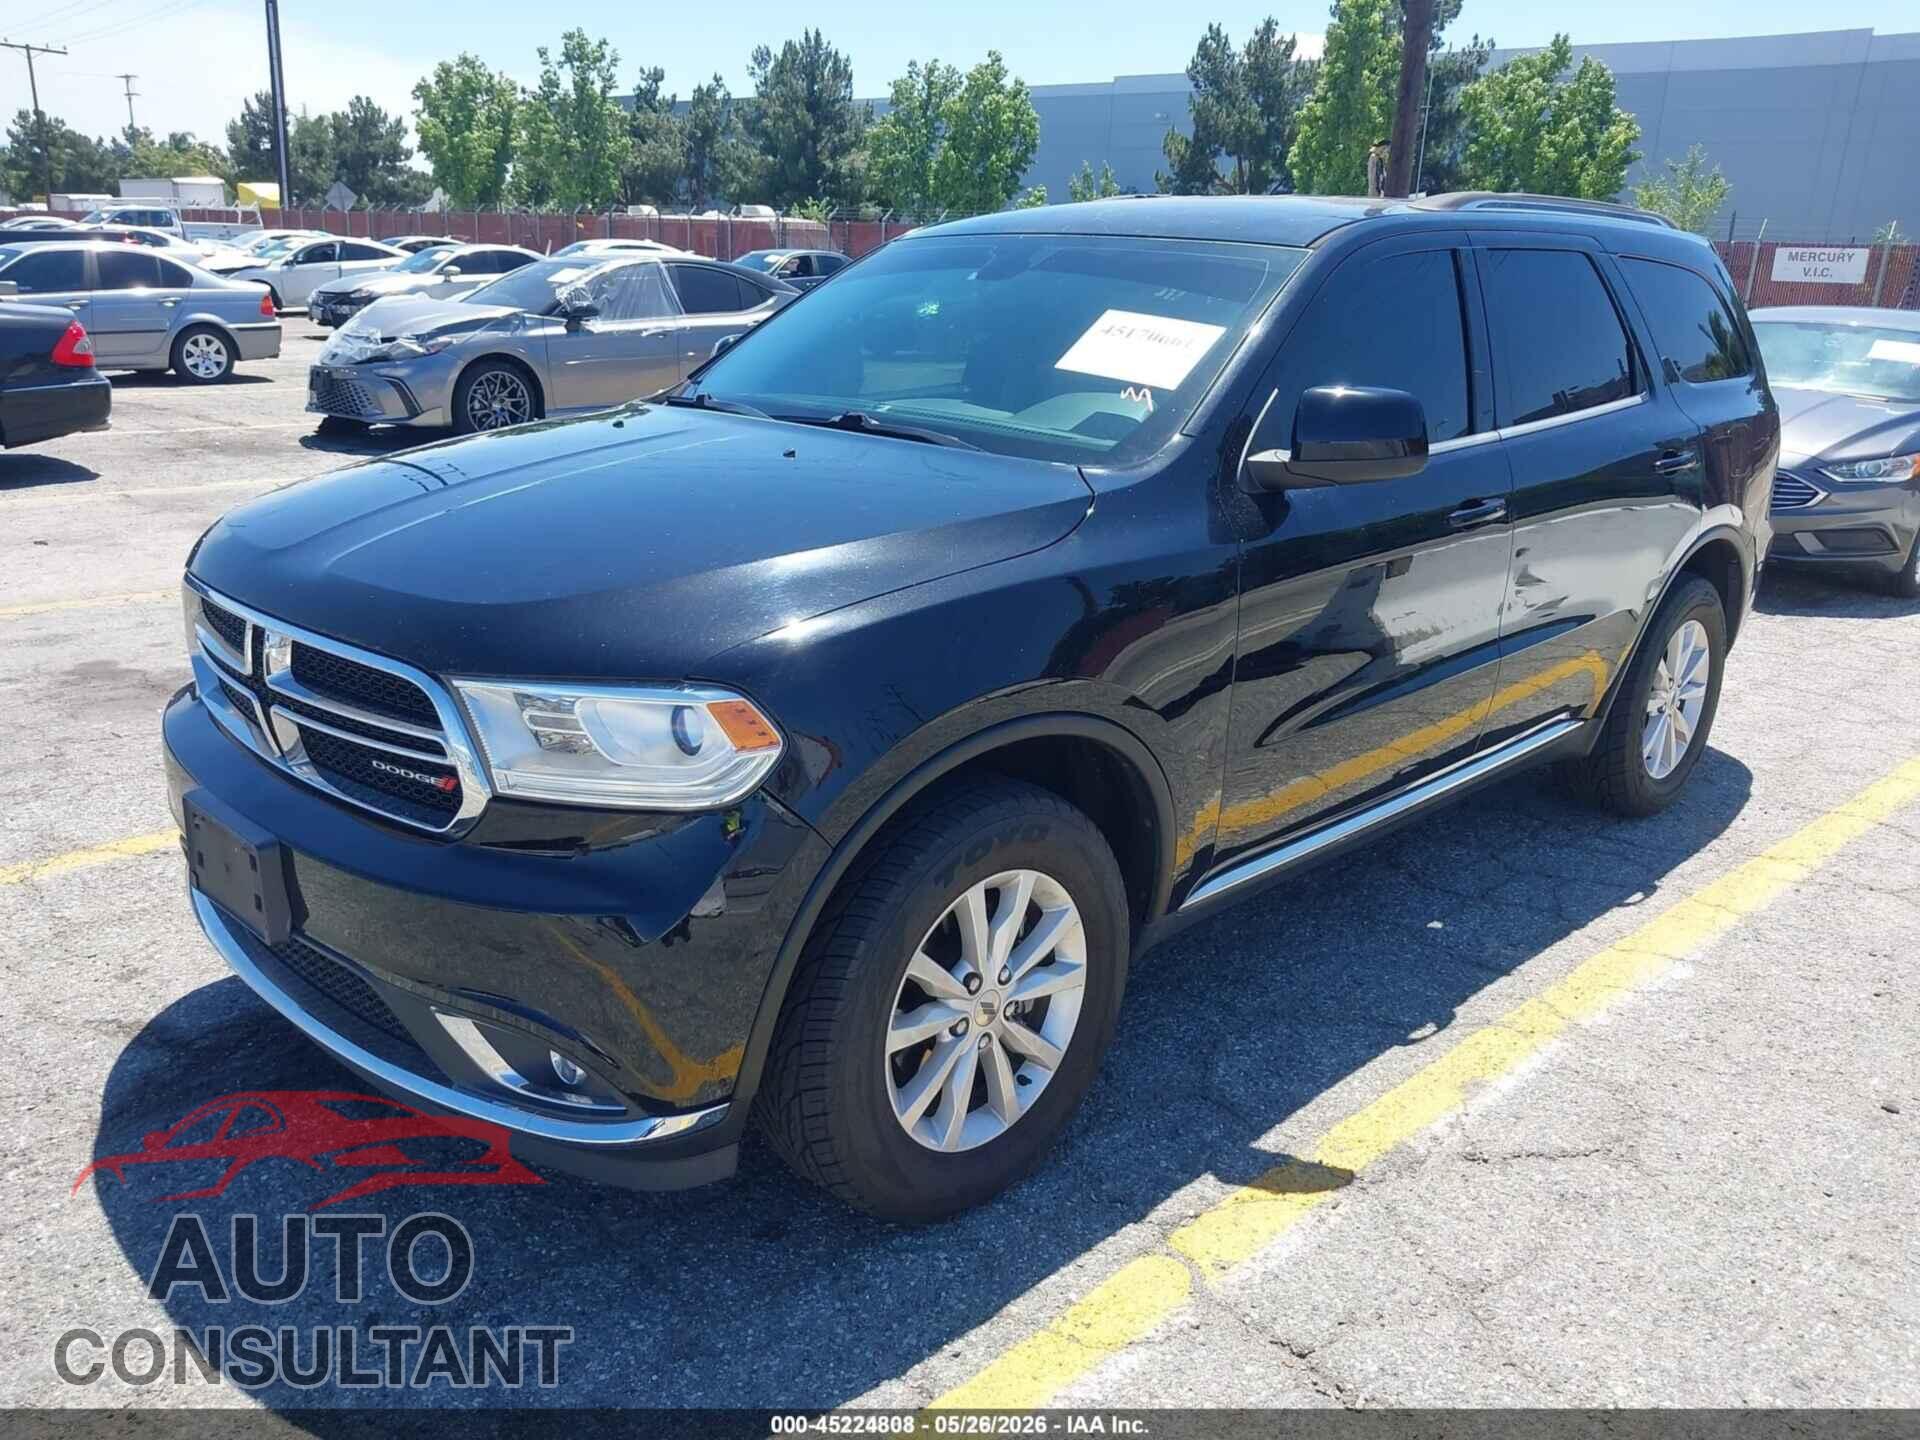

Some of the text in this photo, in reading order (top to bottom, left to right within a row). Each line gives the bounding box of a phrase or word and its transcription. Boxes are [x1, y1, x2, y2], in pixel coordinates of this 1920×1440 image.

[1787, 251, 1855, 263] MERCURY
[1802, 267, 1833, 278] V.I.C.
[372, 760, 445, 788] DODGE
